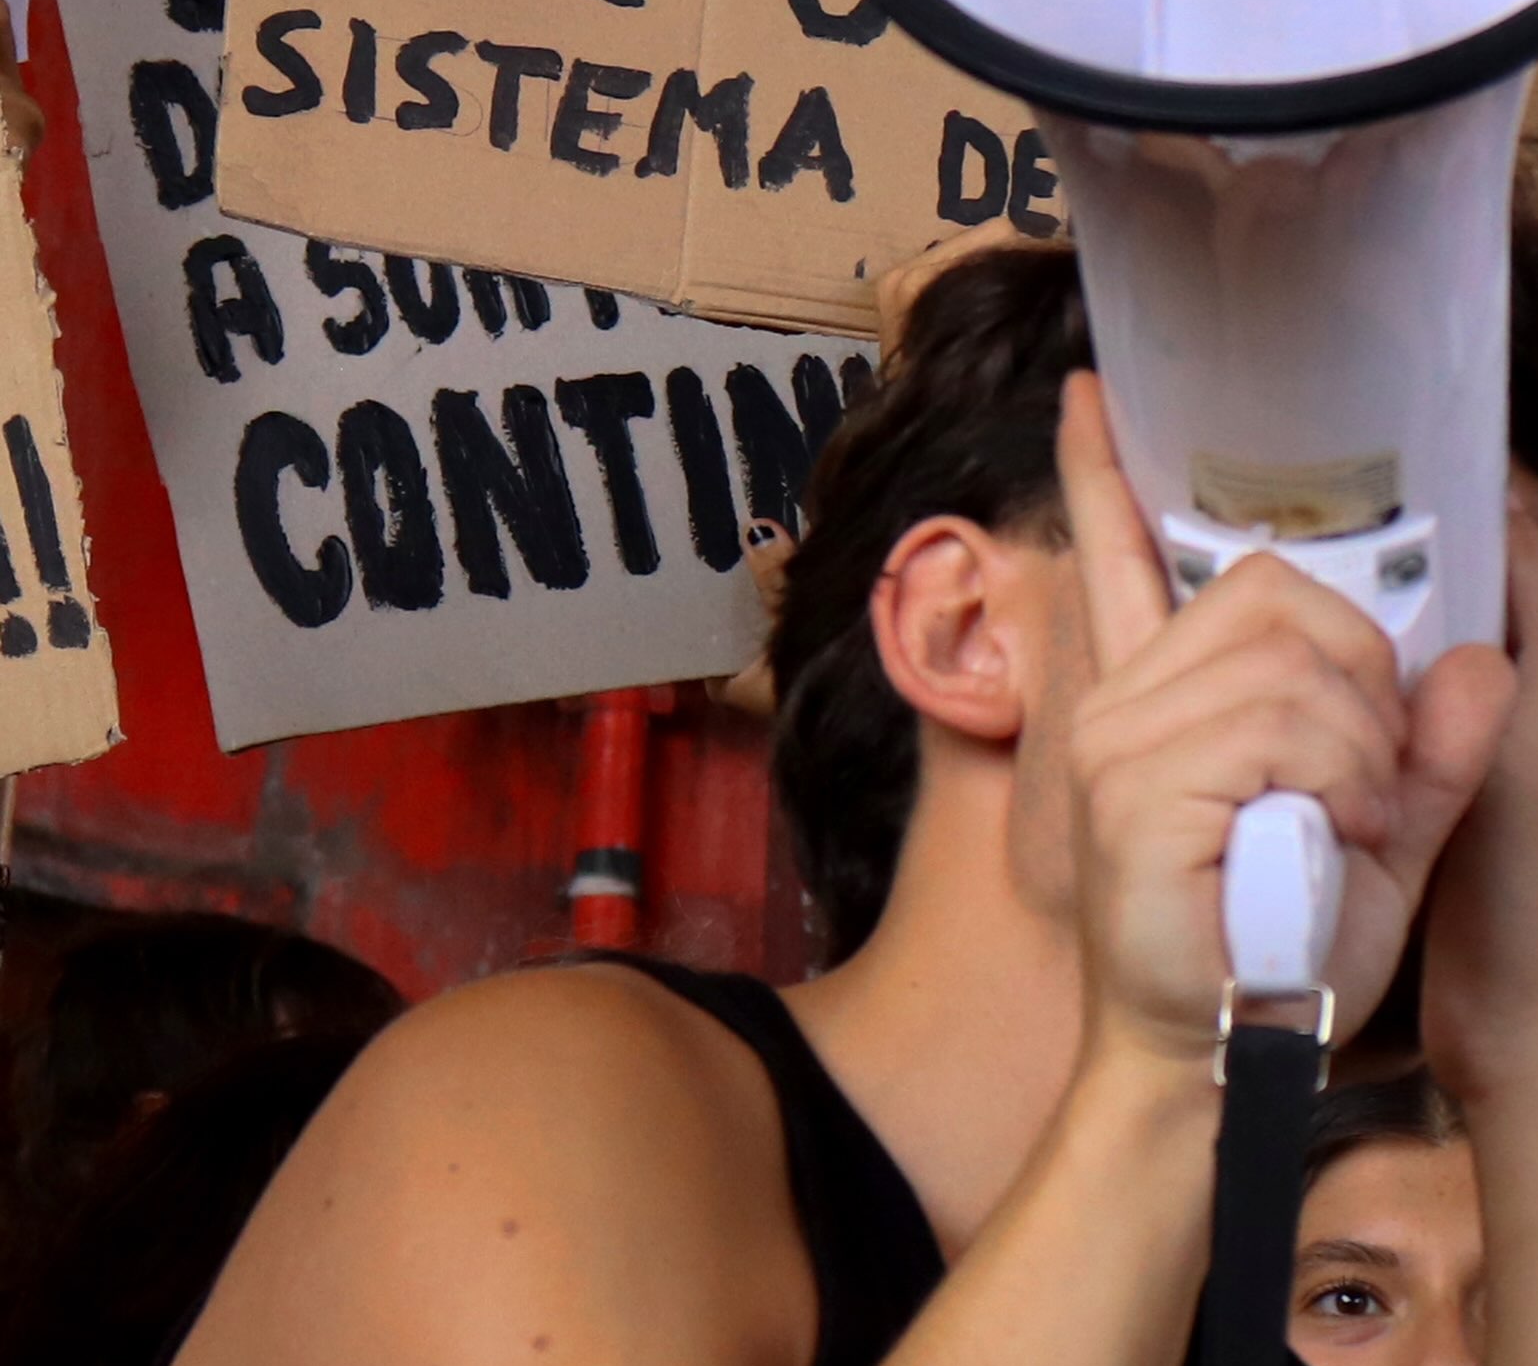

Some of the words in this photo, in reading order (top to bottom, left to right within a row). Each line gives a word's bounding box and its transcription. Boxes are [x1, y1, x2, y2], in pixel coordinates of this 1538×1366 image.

[241, 8, 855, 205] SISTEMA
[936, 109, 1063, 239] DE
[234, 352, 875, 629] CONTIN
